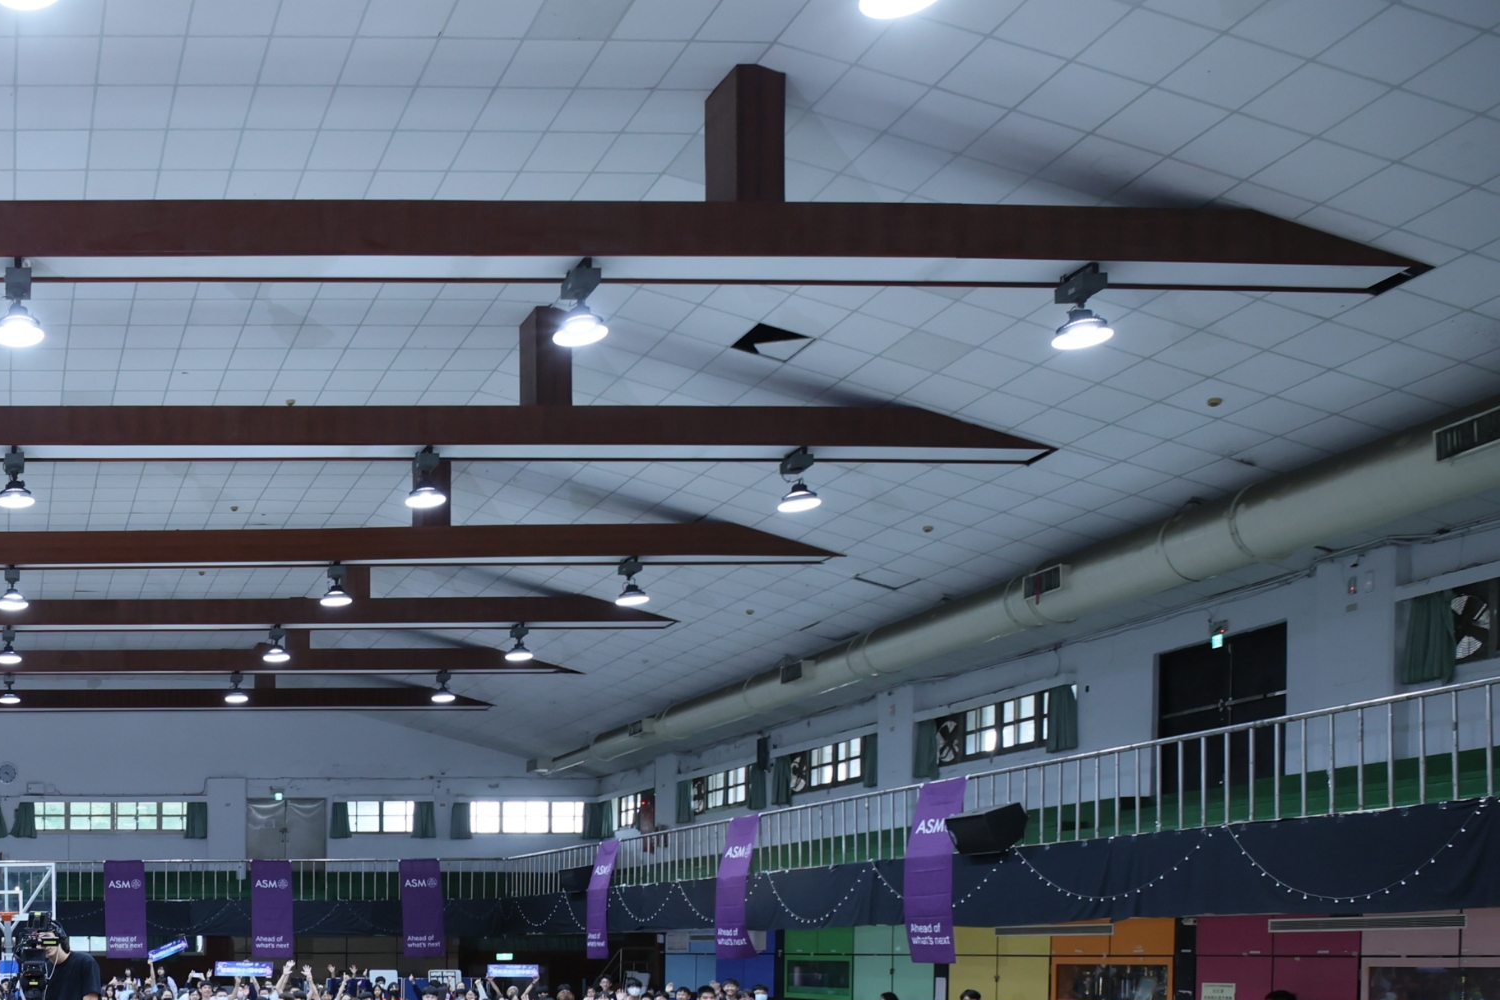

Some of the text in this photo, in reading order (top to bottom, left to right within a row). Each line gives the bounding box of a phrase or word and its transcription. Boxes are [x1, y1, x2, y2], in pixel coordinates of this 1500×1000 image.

[915, 818, 947, 834] ASM
[725, 845, 746, 859] ASM
[108, 879, 131, 889] ASM
[255, 879, 278, 889] ASM
[404, 878, 427, 888] ASM
[717, 927, 739, 936] Ahead of
[910, 922, 941, 933] Ahead of
[911, 935, 951, 945] what's next
